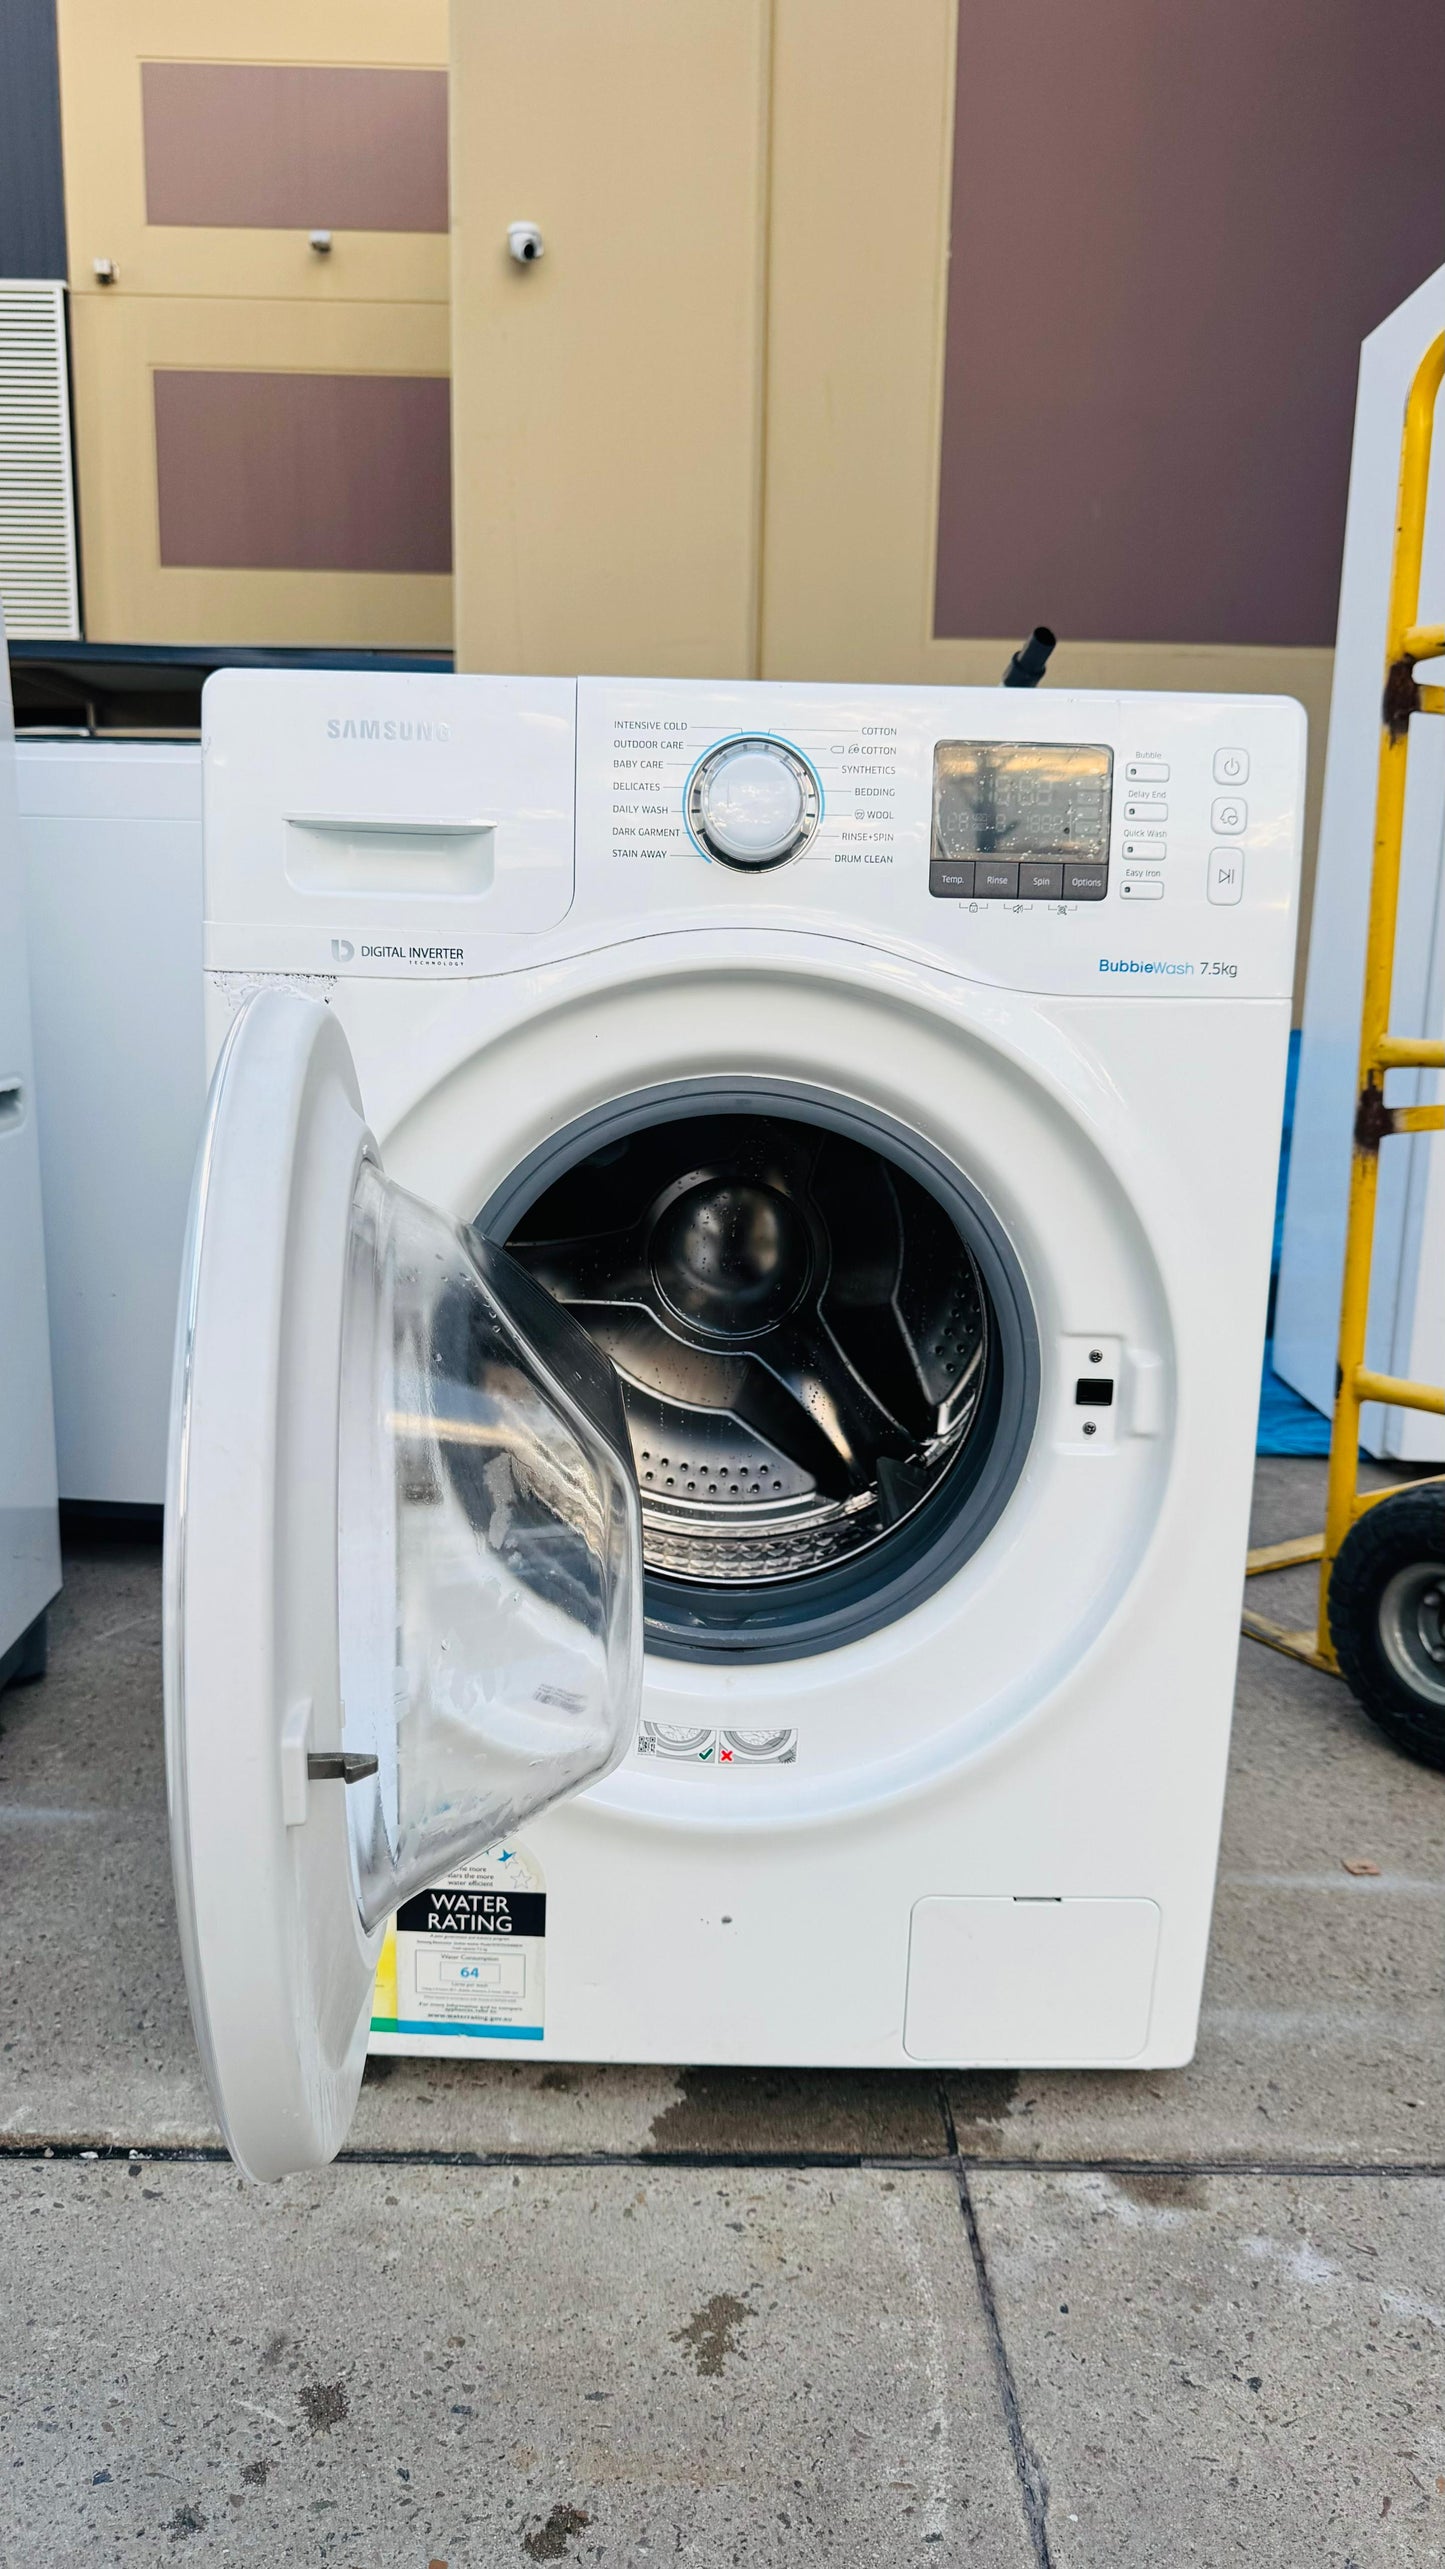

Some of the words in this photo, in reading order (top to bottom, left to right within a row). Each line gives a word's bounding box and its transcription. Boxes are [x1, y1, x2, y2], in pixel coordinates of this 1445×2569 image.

[326, 719, 452, 742] SAMSUNG
[614, 721, 661, 730] INTENSIVE
[663, 722, 688, 731] COLD
[861, 727, 897, 736] COTTON
[613, 740, 658, 749] OUTDOOR
[660, 741, 685, 750] CARE
[861, 746, 897, 755] COTTON
[1135, 751, 1162, 759] Bubble
[613, 760, 638, 769] BABY
[640, 760, 664, 769] CARE
[841, 765, 896, 774] SYNTHETICS
[613, 782, 661, 791] DELICATES
[854, 787, 896, 797] BEDDING
[1128, 789, 1150, 799] Delay
[1151, 790, 1167, 799] End
[612, 805, 639, 814] DAILY
[641, 805, 669, 814] WASH
[866, 810, 894, 820] WOOL
[612, 827, 636, 836] DARK
[638, 828, 681, 837] GARMENT
[841, 832, 895, 842] RINSE+SPIN
[1123, 828, 1145, 838] Quick
[1146, 829, 1167, 838] Wash
[612, 849, 638, 858] STAIN
[640, 849, 668, 859] AWAY
[834, 854, 862, 863] DRUM
[863, 854, 894, 864] CLEAN
[1125, 868, 1143, 878] Easy
[1145, 868, 1161, 877] Iron
[942, 874, 965, 885] Temp.
[986, 875, 1009, 885] Rinse
[1032, 876, 1050, 887] Spin
[1071, 877, 1102, 888] Options
[361, 946, 406, 958] DIGITAL
[409, 947, 464, 960] INVERTER
[1200, 962, 1238, 978] 7.5kg
[431, 1893, 510, 1914] WATER
[428, 1913, 512, 1933] RATING
[460, 1967, 479, 1978] 64
